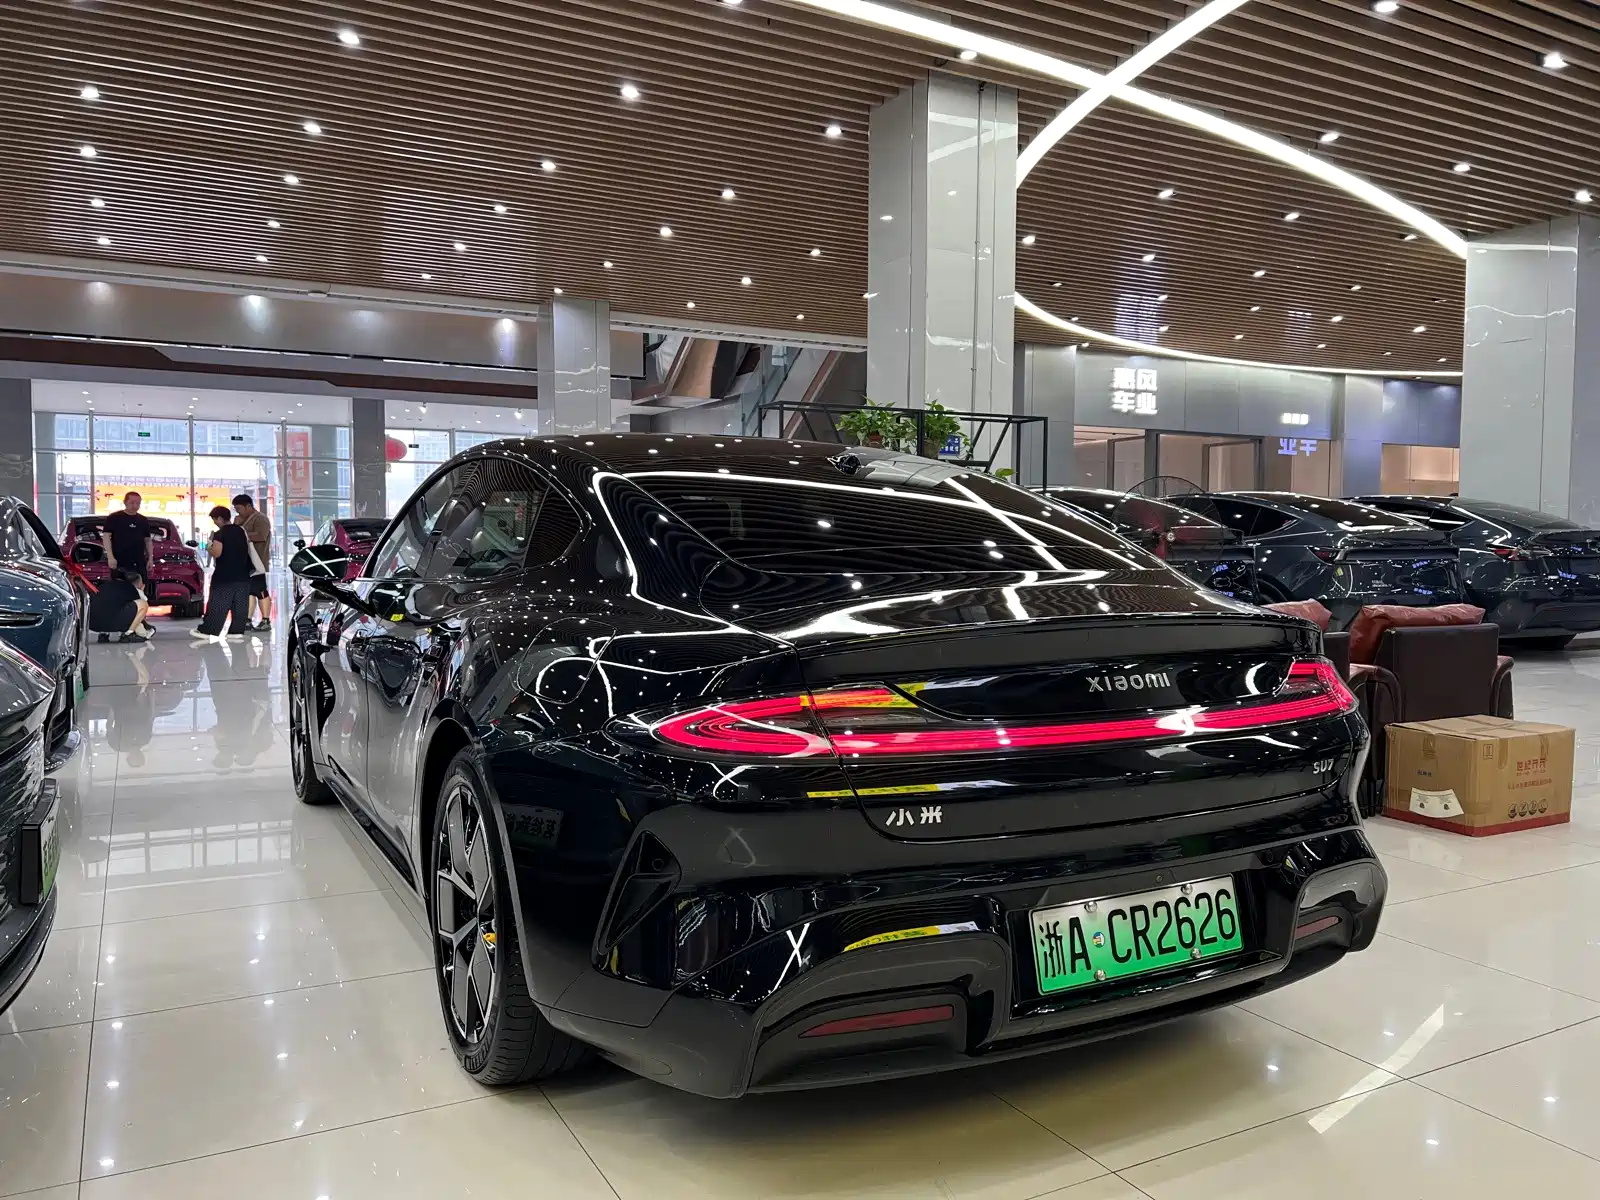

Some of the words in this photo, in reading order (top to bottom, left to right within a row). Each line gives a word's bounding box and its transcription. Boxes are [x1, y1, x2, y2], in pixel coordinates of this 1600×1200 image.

[1111, 390, 1158, 415] 车业
[1312, 758, 1335, 774] SU7
[885, 805, 942, 827] 小米
[1038, 916, 1092, 979] 浙A
[1107, 888, 1237, 964] CR2626
